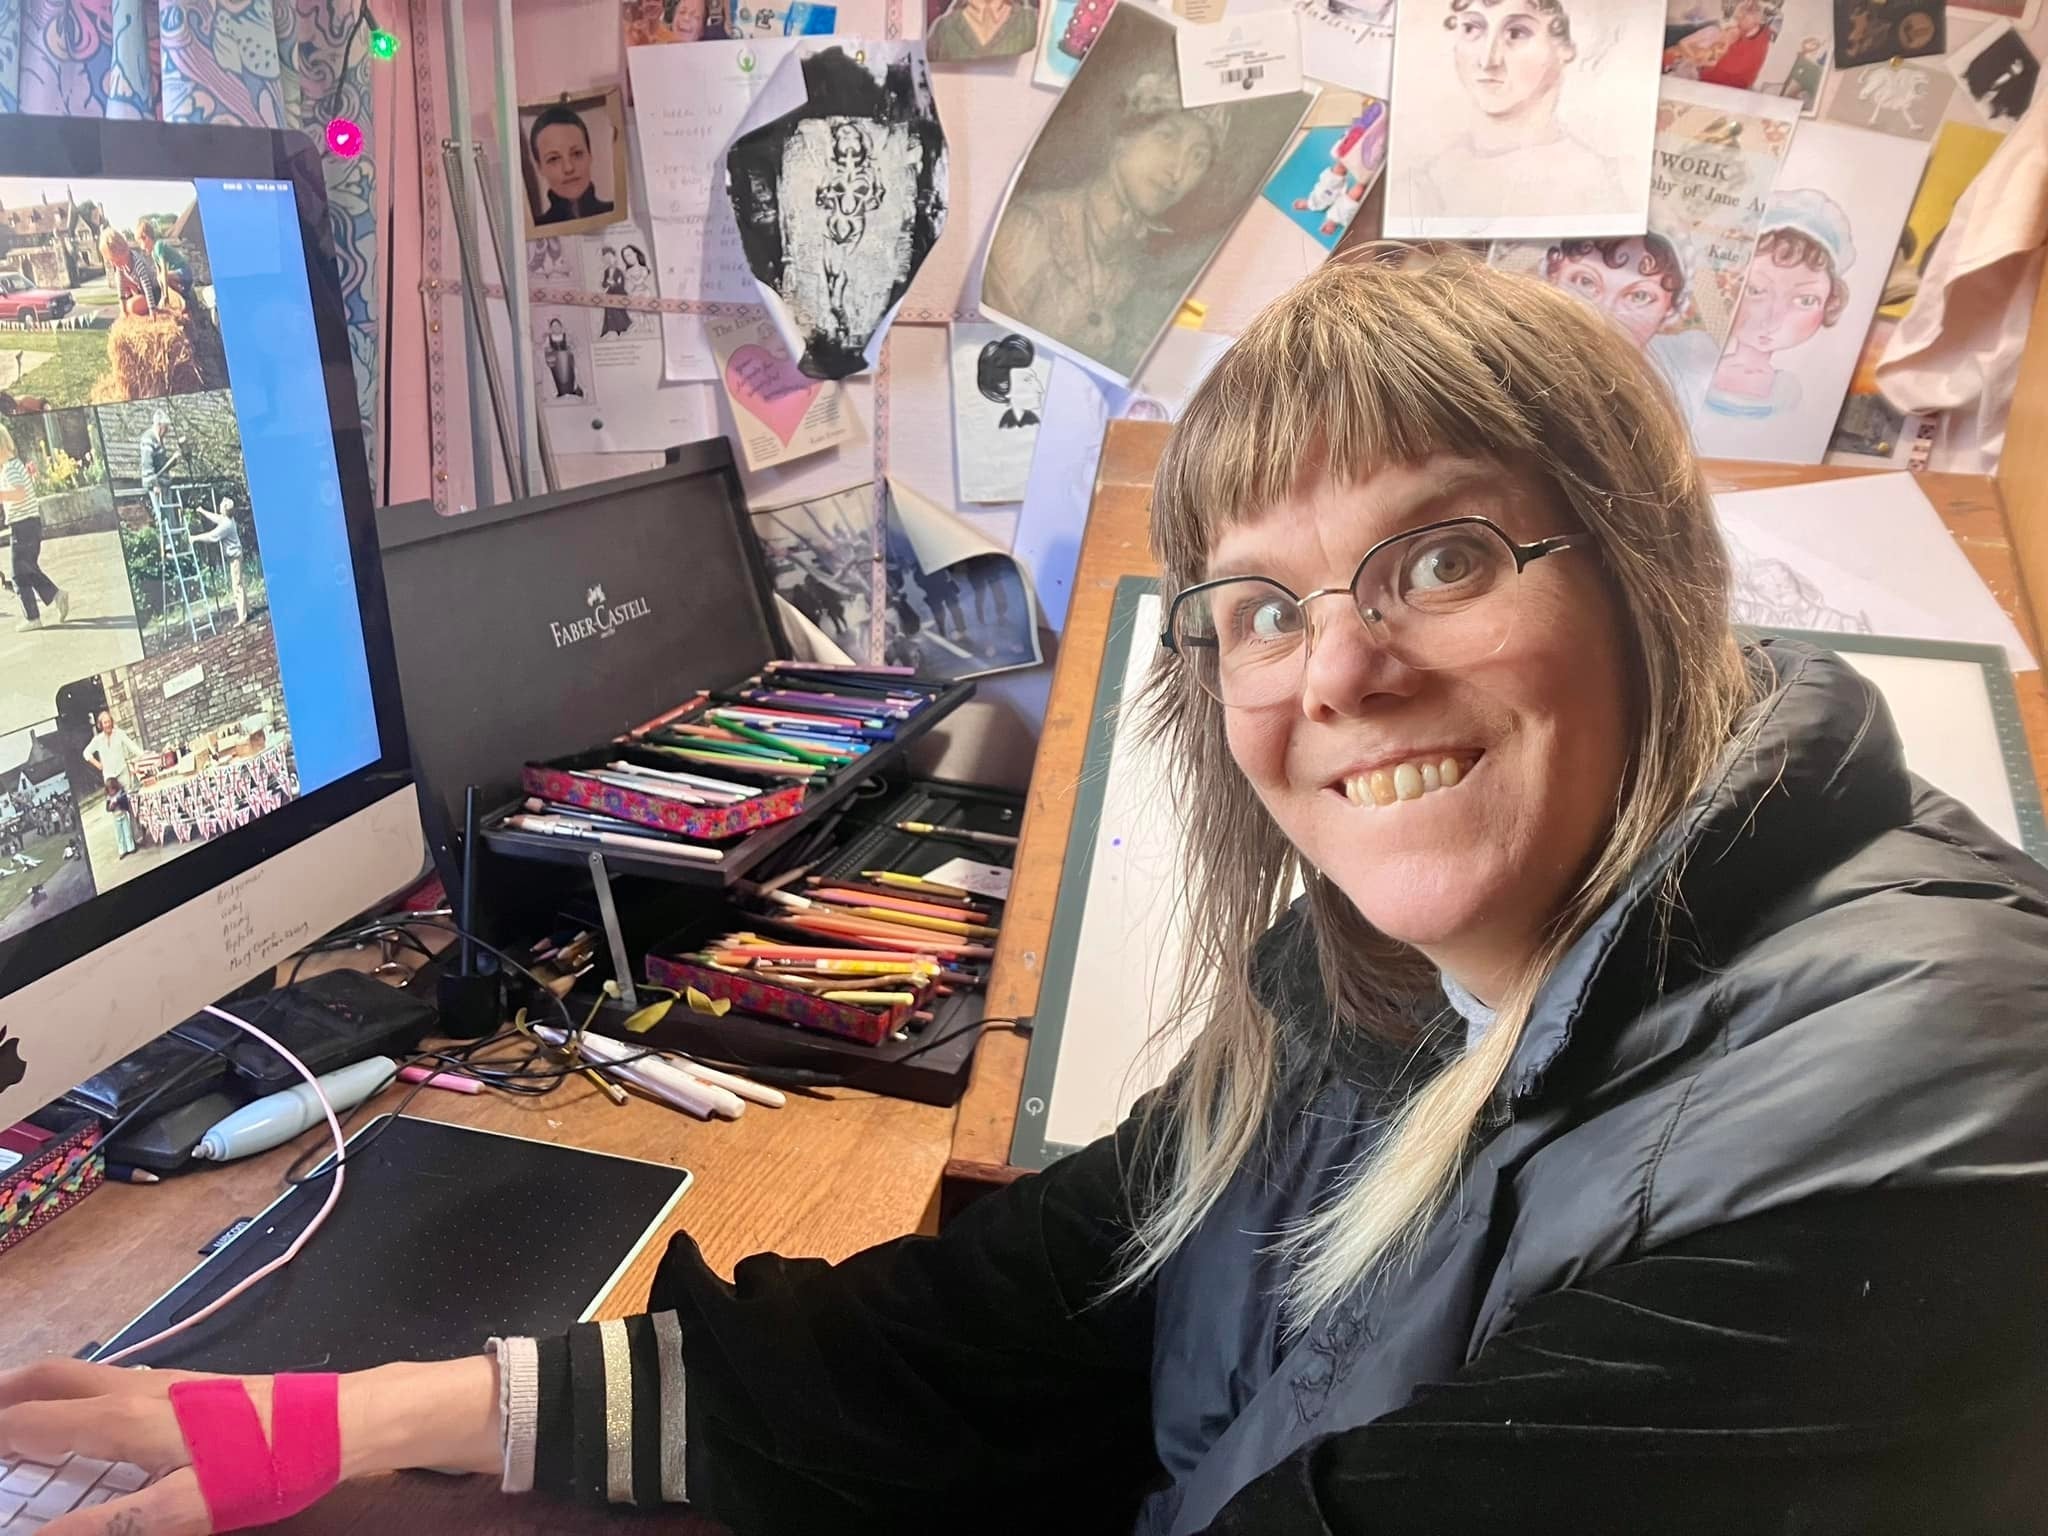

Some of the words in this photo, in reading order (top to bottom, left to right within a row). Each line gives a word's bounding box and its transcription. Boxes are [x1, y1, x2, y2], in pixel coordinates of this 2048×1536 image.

[1683, 184, 1703, 198] of
[1705, 186, 1740, 207] Jane
[1708, 243, 1740, 262] Kate
